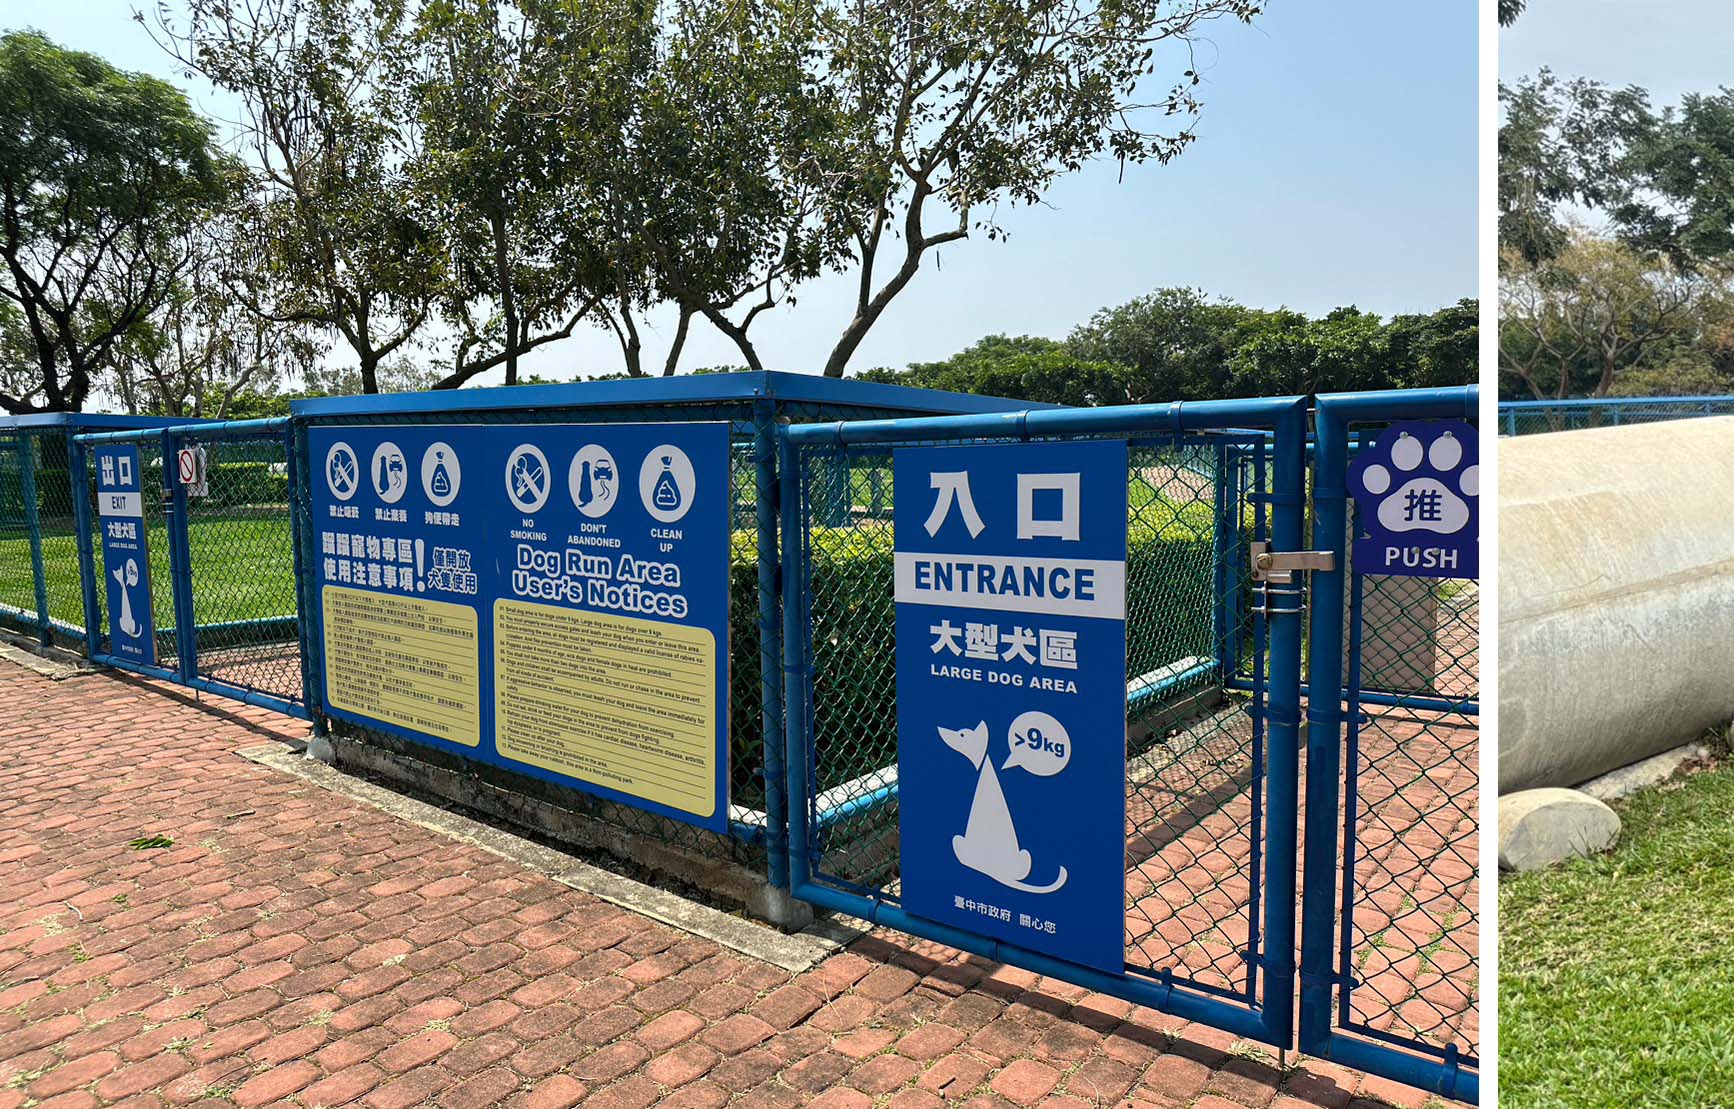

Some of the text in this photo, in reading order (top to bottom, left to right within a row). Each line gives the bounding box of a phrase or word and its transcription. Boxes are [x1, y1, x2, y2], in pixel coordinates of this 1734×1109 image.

[101, 456, 132, 486] 出口
[112, 496, 126, 510] EXIT
[329, 504, 360, 519] 禁止吸菸
[923, 470, 1081, 541] 入口
[1404, 489, 1442, 521] 推
[375, 508, 408, 522] 禁止棄養
[425, 511, 460, 526] 狗便帶走
[522, 518, 534, 528] NO
[108, 522, 136, 540] 大型犬區
[510, 530, 547, 542] SMOKING
[580, 523, 607, 534] DON'T
[650, 528, 682, 540] CLEAN
[568, 535, 621, 548] ABANDONED
[660, 542, 673, 552] UP
[433, 547, 470, 572] 僅開放
[518, 544, 681, 587] Dog Run Area
[1385, 546, 1458, 568] PUSH
[428, 570, 477, 595] 犬隻使用
[914, 560, 1095, 600] ENTRANCE
[512, 570, 688, 618] User's Notices
[930, 620, 1078, 670] 大型犬區
[930, 664, 1078, 694] LARGE DOG AREA
[1014, 728, 1065, 758] >9kg
[954, 895, 1056, 934] 臺中市政府 關心您
